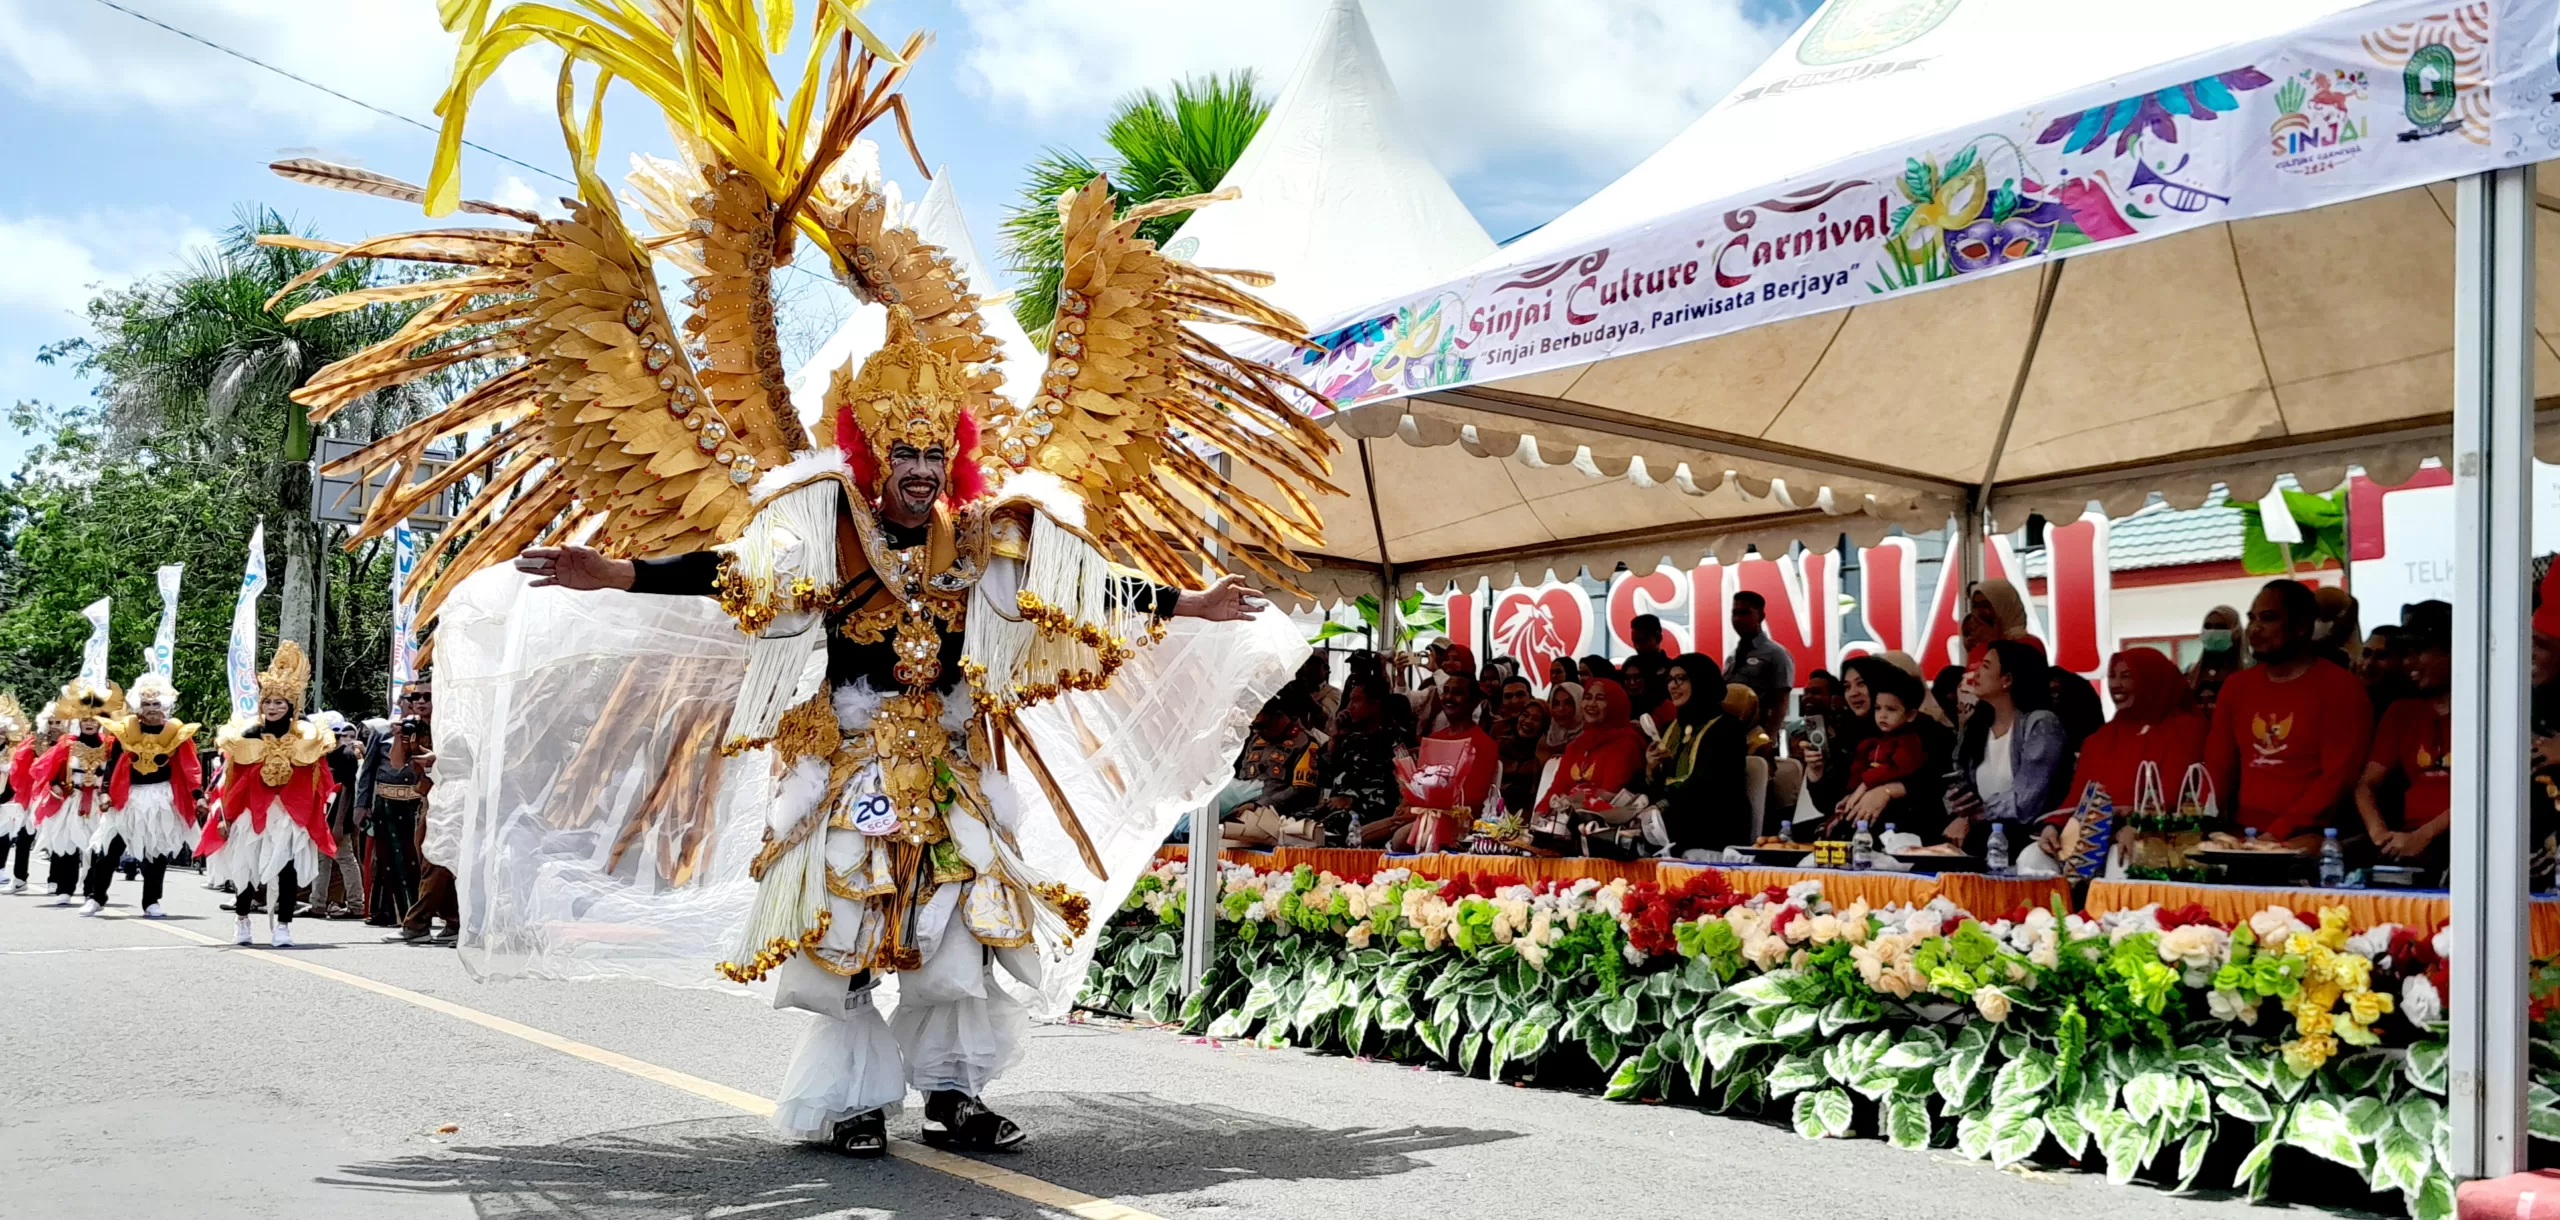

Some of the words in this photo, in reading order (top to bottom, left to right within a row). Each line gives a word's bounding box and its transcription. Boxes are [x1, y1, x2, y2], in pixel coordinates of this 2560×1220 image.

[2271, 115, 2368, 157] SINJAI
[1454, 288, 1553, 349] Sinjai
[1567, 261, 1698, 326] Culture
[1715, 195, 1891, 289] Carnival
[1540, 319, 1646, 354] Berbudaya,
[1651, 290, 1755, 329] Pariwisata
[1608, 512, 2112, 694] SINJAI
[856, 795, 890, 824] 20
[867, 819, 891, 831] SCC
